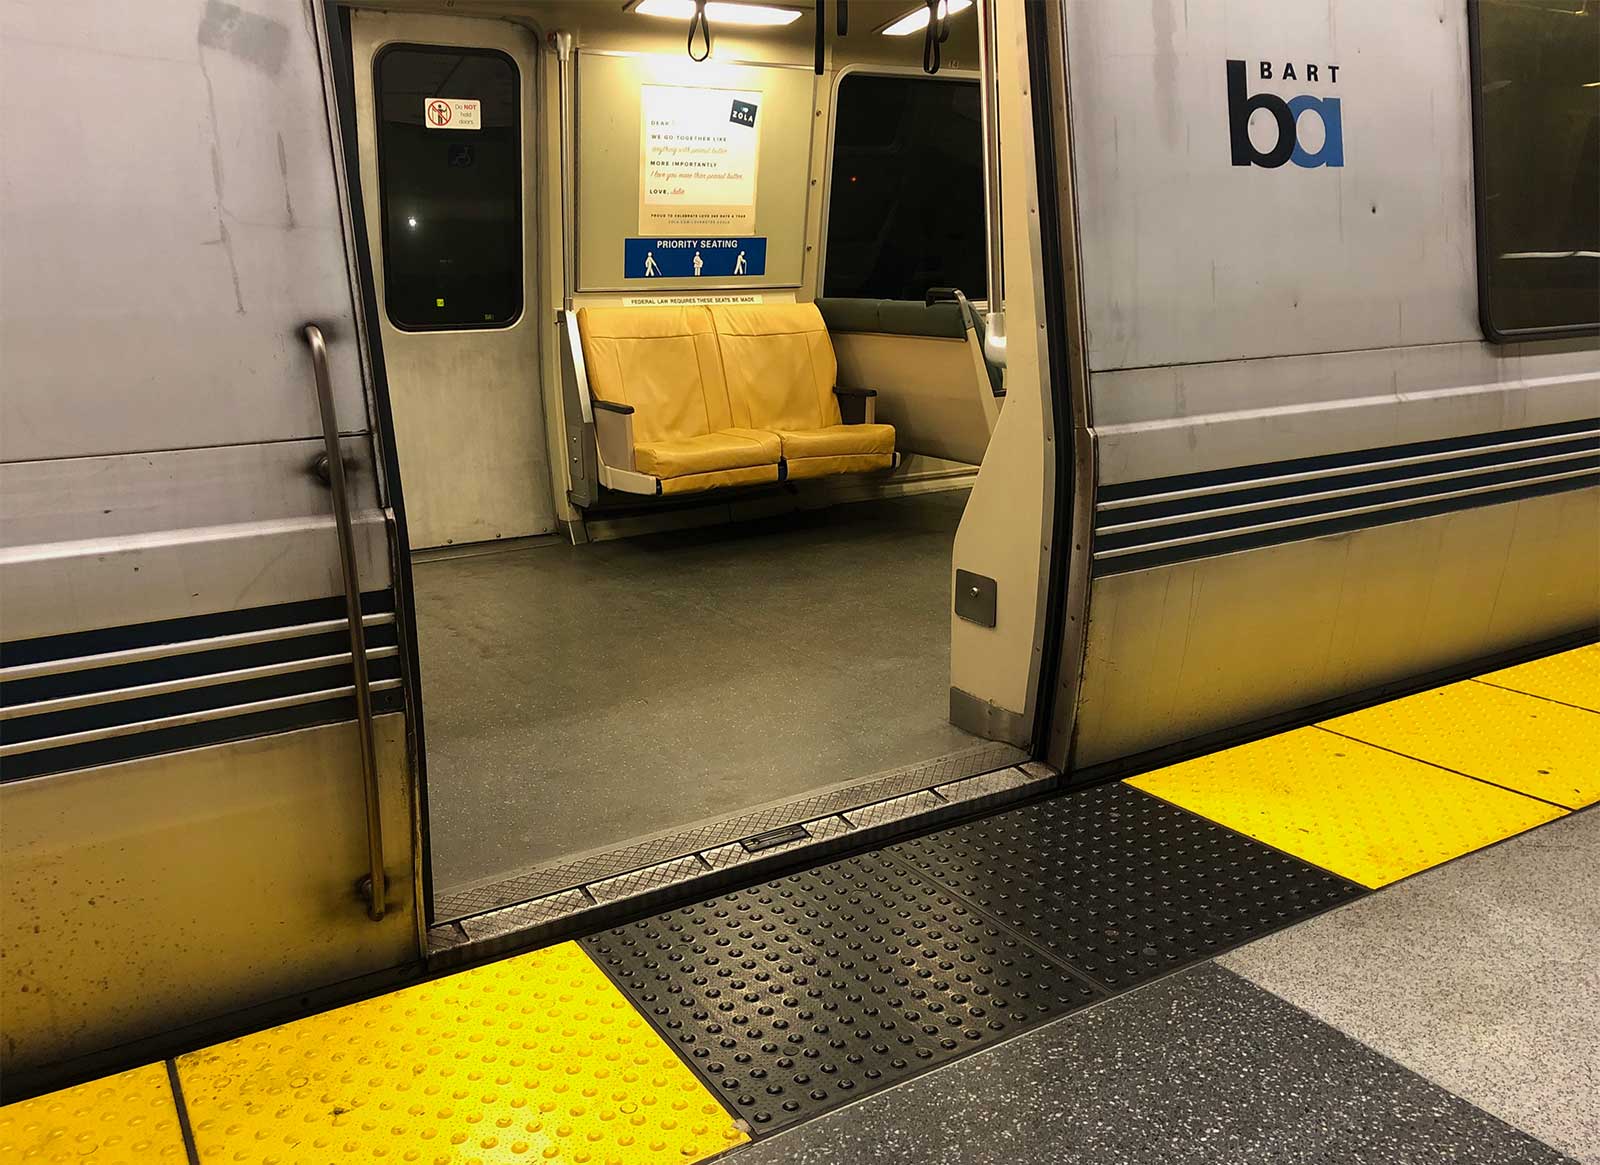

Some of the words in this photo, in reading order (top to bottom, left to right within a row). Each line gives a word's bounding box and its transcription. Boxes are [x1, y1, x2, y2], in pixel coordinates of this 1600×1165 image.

[1260, 61, 1339, 83] BART
[732, 110, 754, 123] ZOLA
[1226, 59, 1344, 168] ba
[652, 146, 677, 155] anything
[666, 172, 678, 181] you
[657, 240, 698, 249] PRIORITY
[700, 239, 738, 249] SEATING
